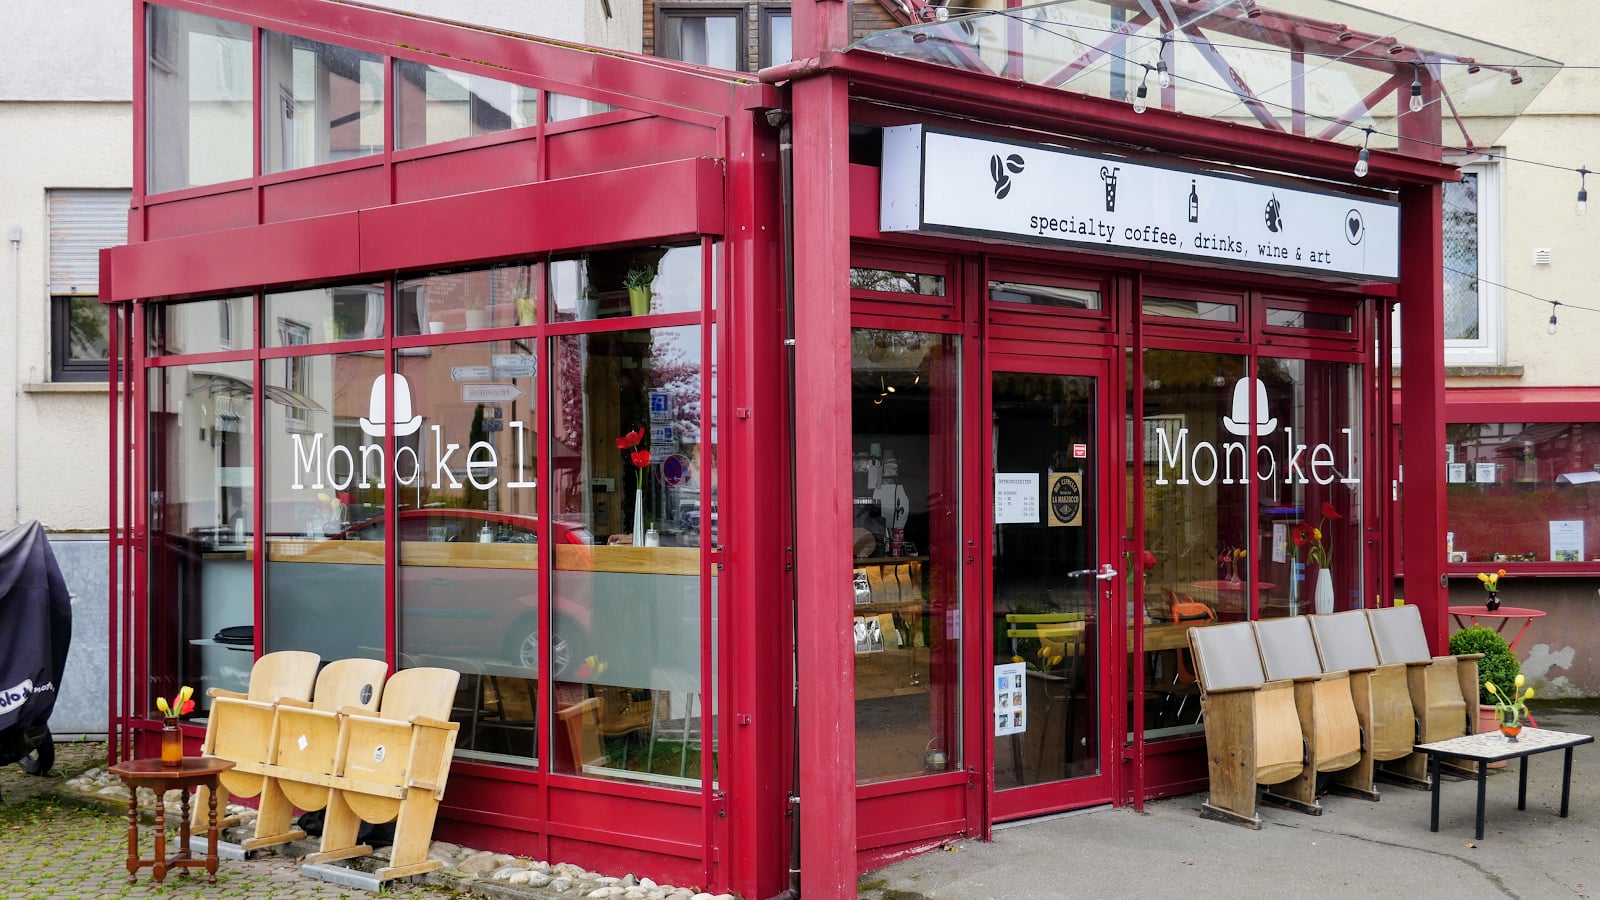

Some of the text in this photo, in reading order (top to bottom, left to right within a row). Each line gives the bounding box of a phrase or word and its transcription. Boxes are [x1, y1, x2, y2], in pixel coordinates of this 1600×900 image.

[1030, 214, 1332, 264] specialty coffee, drinks, wine & art
[292, 421, 537, 490] Monokel
[1155, 426, 1361, 486] Monokel
